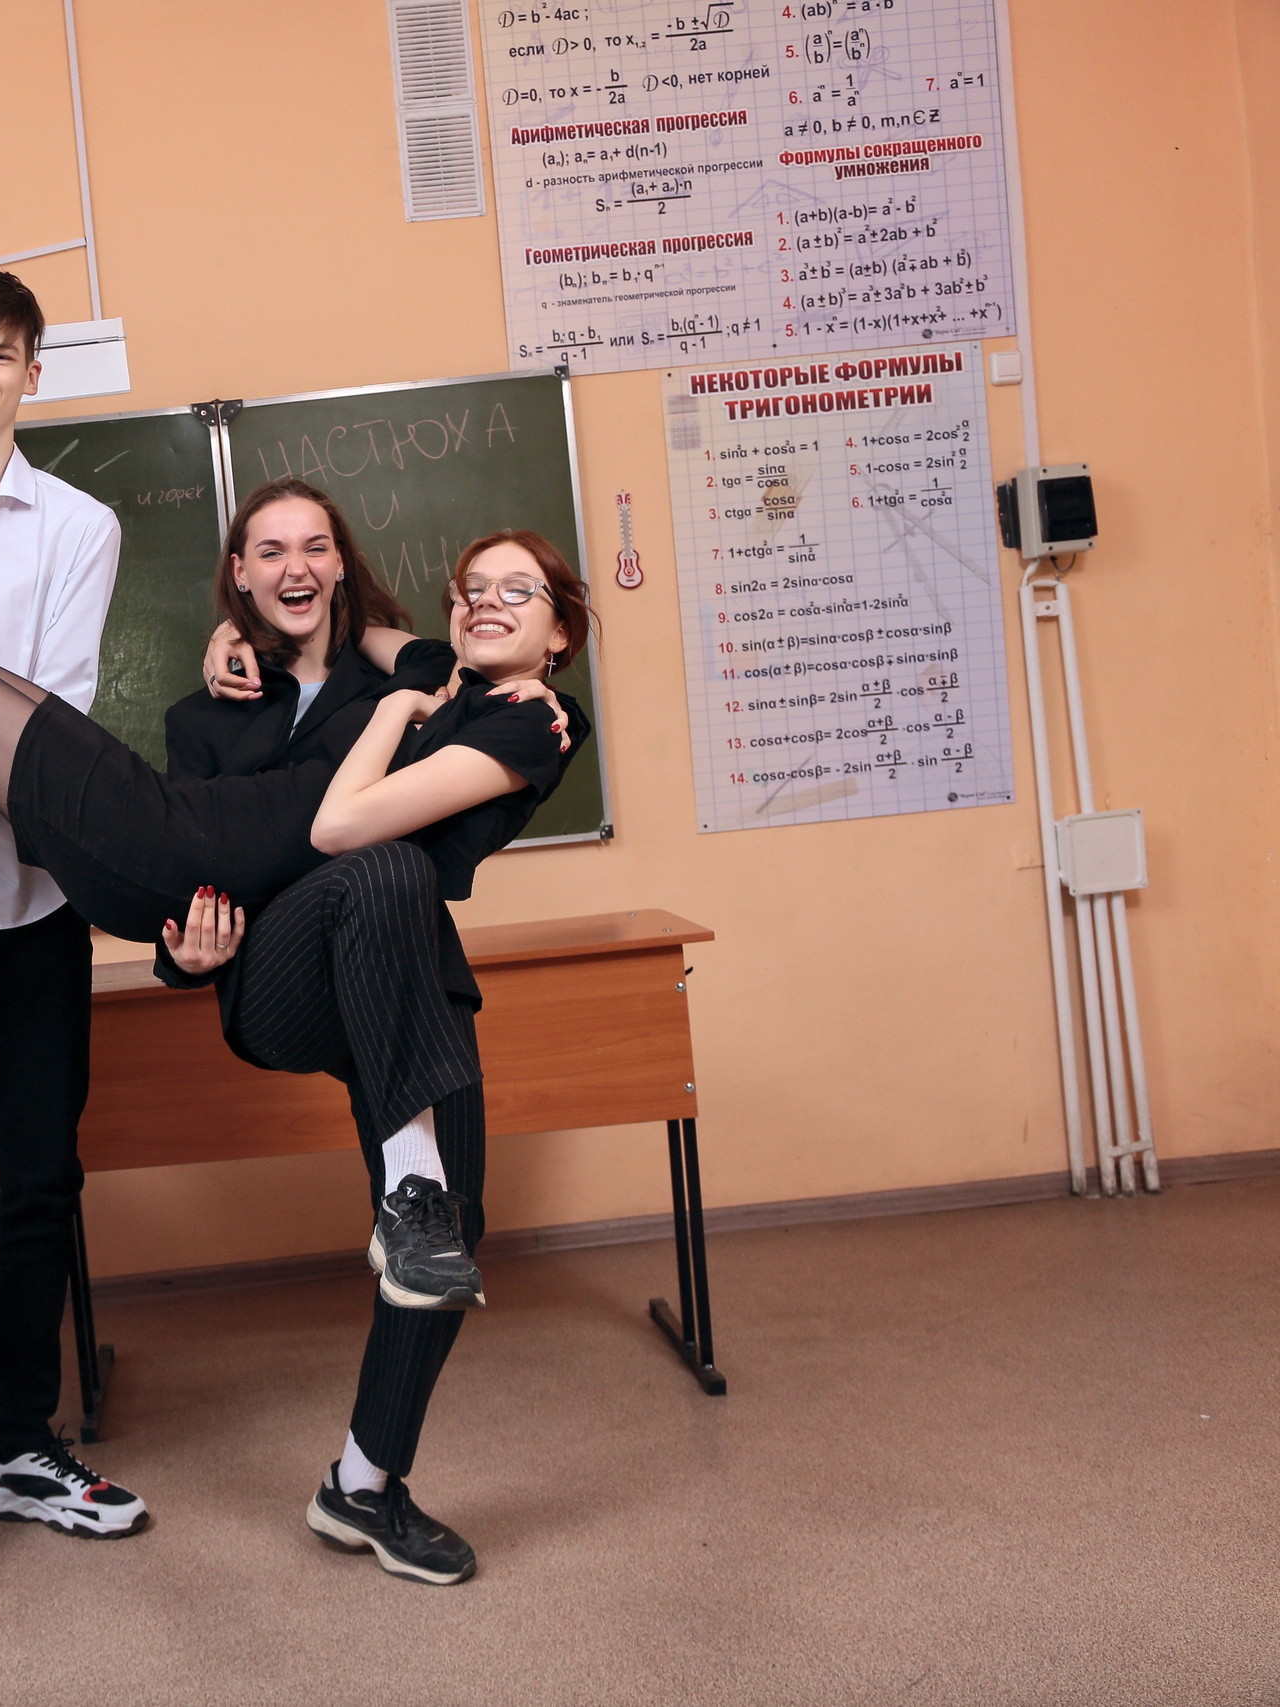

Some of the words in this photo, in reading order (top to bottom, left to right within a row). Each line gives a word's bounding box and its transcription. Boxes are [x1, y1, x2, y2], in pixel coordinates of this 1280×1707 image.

[782, 5, 796, 19] 4.
[509, 45, 544, 58] если
[605, 36, 621, 47] то
[690, 38, 707, 51] 2a
[785, 45, 799, 58] 5.
[688, 71, 713, 84] нет
[718, 65, 770, 84] корней
[926, 78, 940, 91] 7.
[550, 88, 565, 99] то
[609, 91, 626, 104] 2a
[789, 91, 803, 104] 6.
[511, 118, 650, 145] Арифметическая
[656, 110, 748, 132] прогрессия
[779, 146, 861, 166] Формулы
[864, 134, 982, 160] сокращенного
[543, 174, 595, 188] разность
[598, 164, 695, 182] арифметической
[698, 159, 763, 177] прогрессии
[834, 157, 930, 181] умножения
[658, 202, 666, 215] 2
[777, 213, 790, 225] 1.
[525, 240, 656, 266] Геометрическая
[662, 231, 753, 253] прогрессия
[778, 238, 792, 251] 2.
[781, 270, 794, 283] 3.
[557, 294, 613, 307] знаменатель
[615, 287, 684, 302] геометрической
[686, 284, 736, 298] прогрессии
[783, 297, 796, 310] 4.
[785, 324, 798, 337] 5.
[610, 333, 634, 347] или
[691, 363, 829, 394] НЕКОТОРЫЕ
[835, 352, 963, 382] ФОРМУЛЫ
[725, 383, 932, 420] ТРИГОНОМЕТРИИ
[846, 437, 857, 448] 4.
[705, 450, 715, 460] 1.
[850, 464, 861, 475] 5.
[707, 476, 718, 488] 2.
[852, 497, 863, 508] 6.
[709, 508, 720, 519] 3.
[712, 549, 723, 560] 7.
[715, 584, 727, 595] 8.
[718, 612, 730, 623] 9.
[718, 642, 737, 654] 10.
[722, 668, 740, 680] 11.
[725, 702, 744, 713] 12.
[727, 739, 746, 750] 13.
[730, 773, 749, 785] 14.
